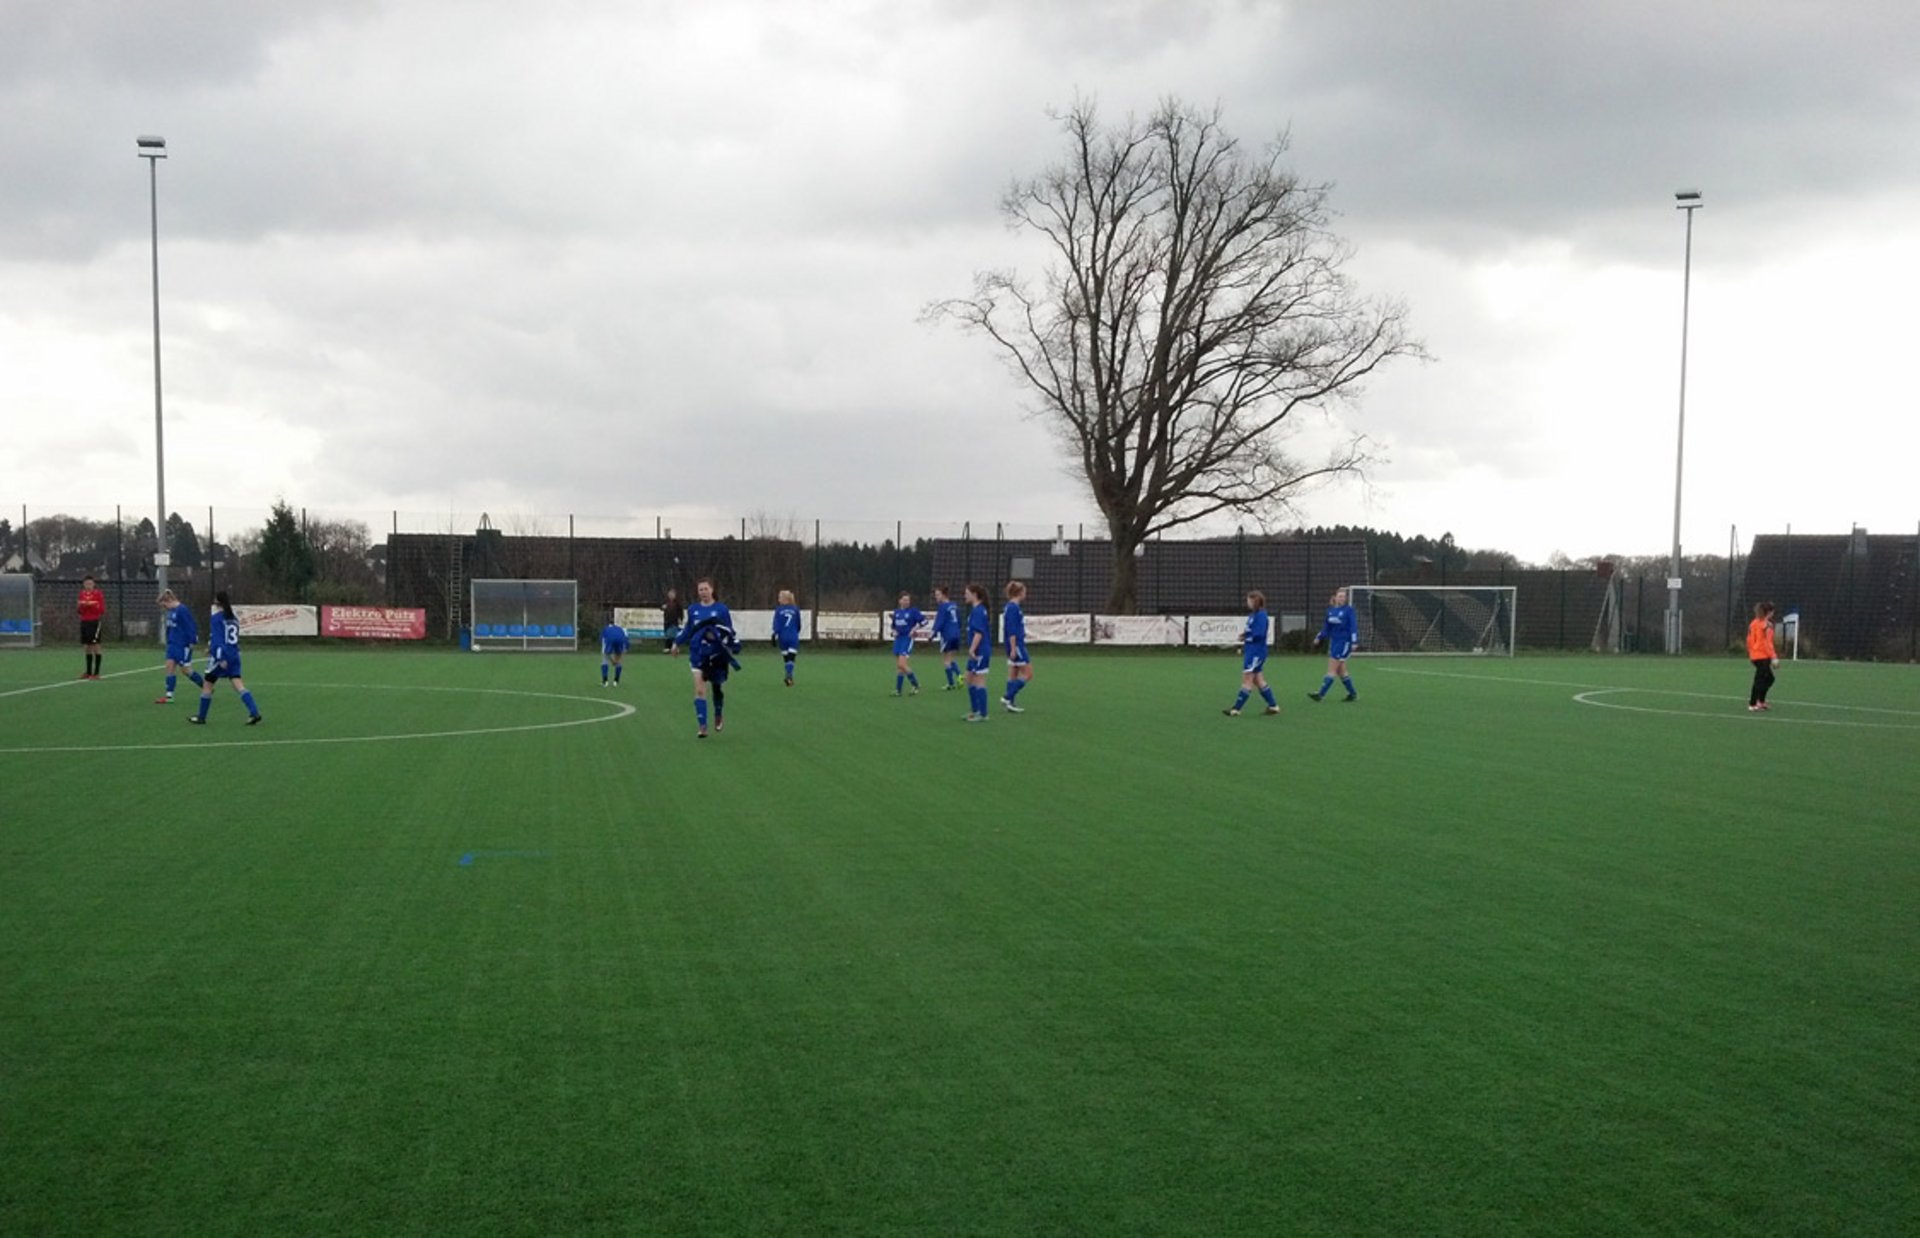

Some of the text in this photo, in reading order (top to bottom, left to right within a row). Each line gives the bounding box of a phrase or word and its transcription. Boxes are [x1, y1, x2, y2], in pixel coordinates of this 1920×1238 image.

[332, 607, 382, 619] Elektro
[784, 613, 793, 627] 7
[225, 624, 238, 645] 13
